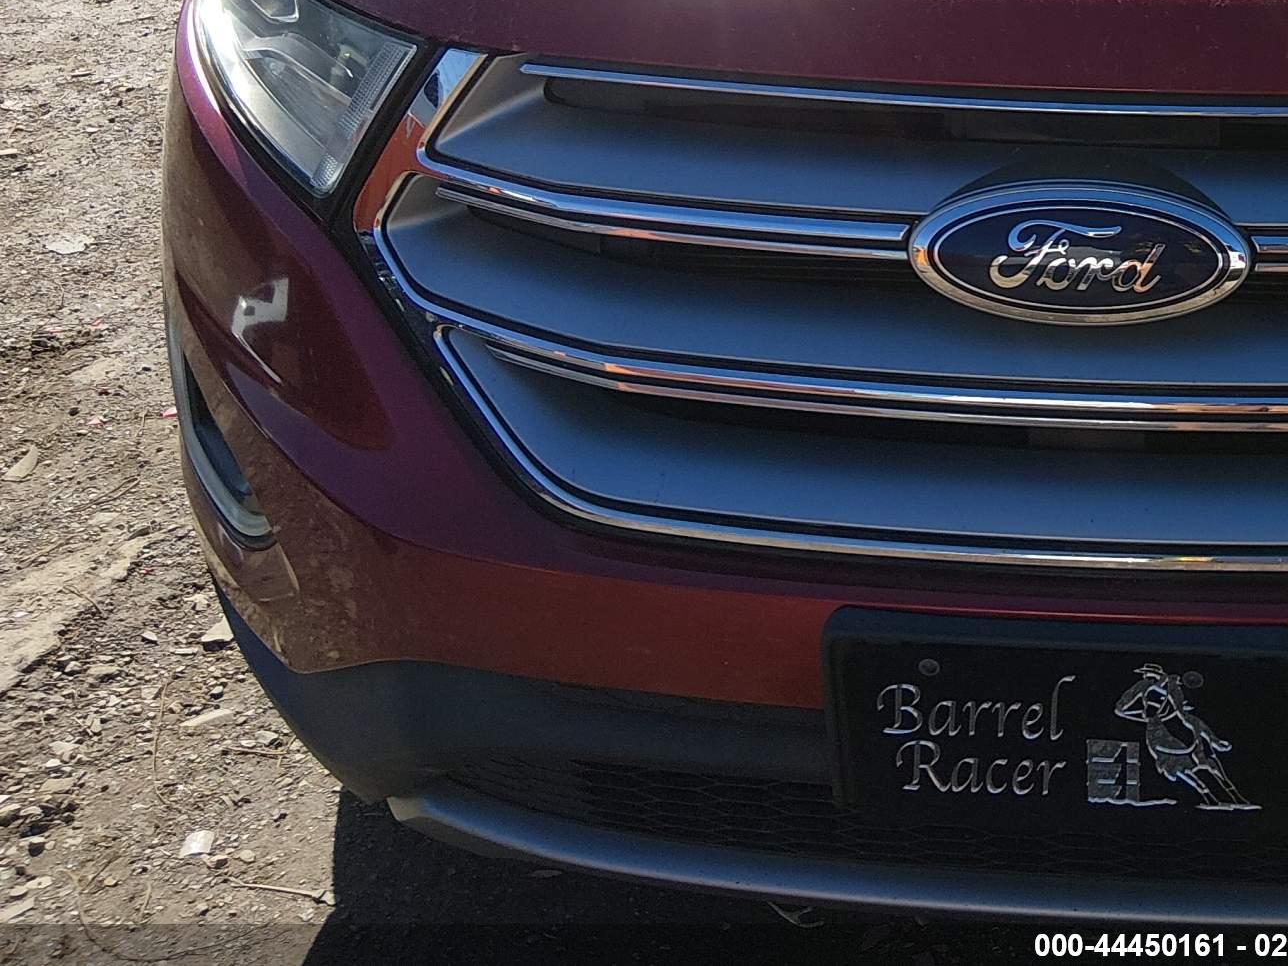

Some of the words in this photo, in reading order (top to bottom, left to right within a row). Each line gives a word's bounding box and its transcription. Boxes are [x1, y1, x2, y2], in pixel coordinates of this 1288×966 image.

[989, 219, 1166, 293] Ford
[876, 675, 1076, 741] Barrel
[896, 740, 1067, 795] Racer
